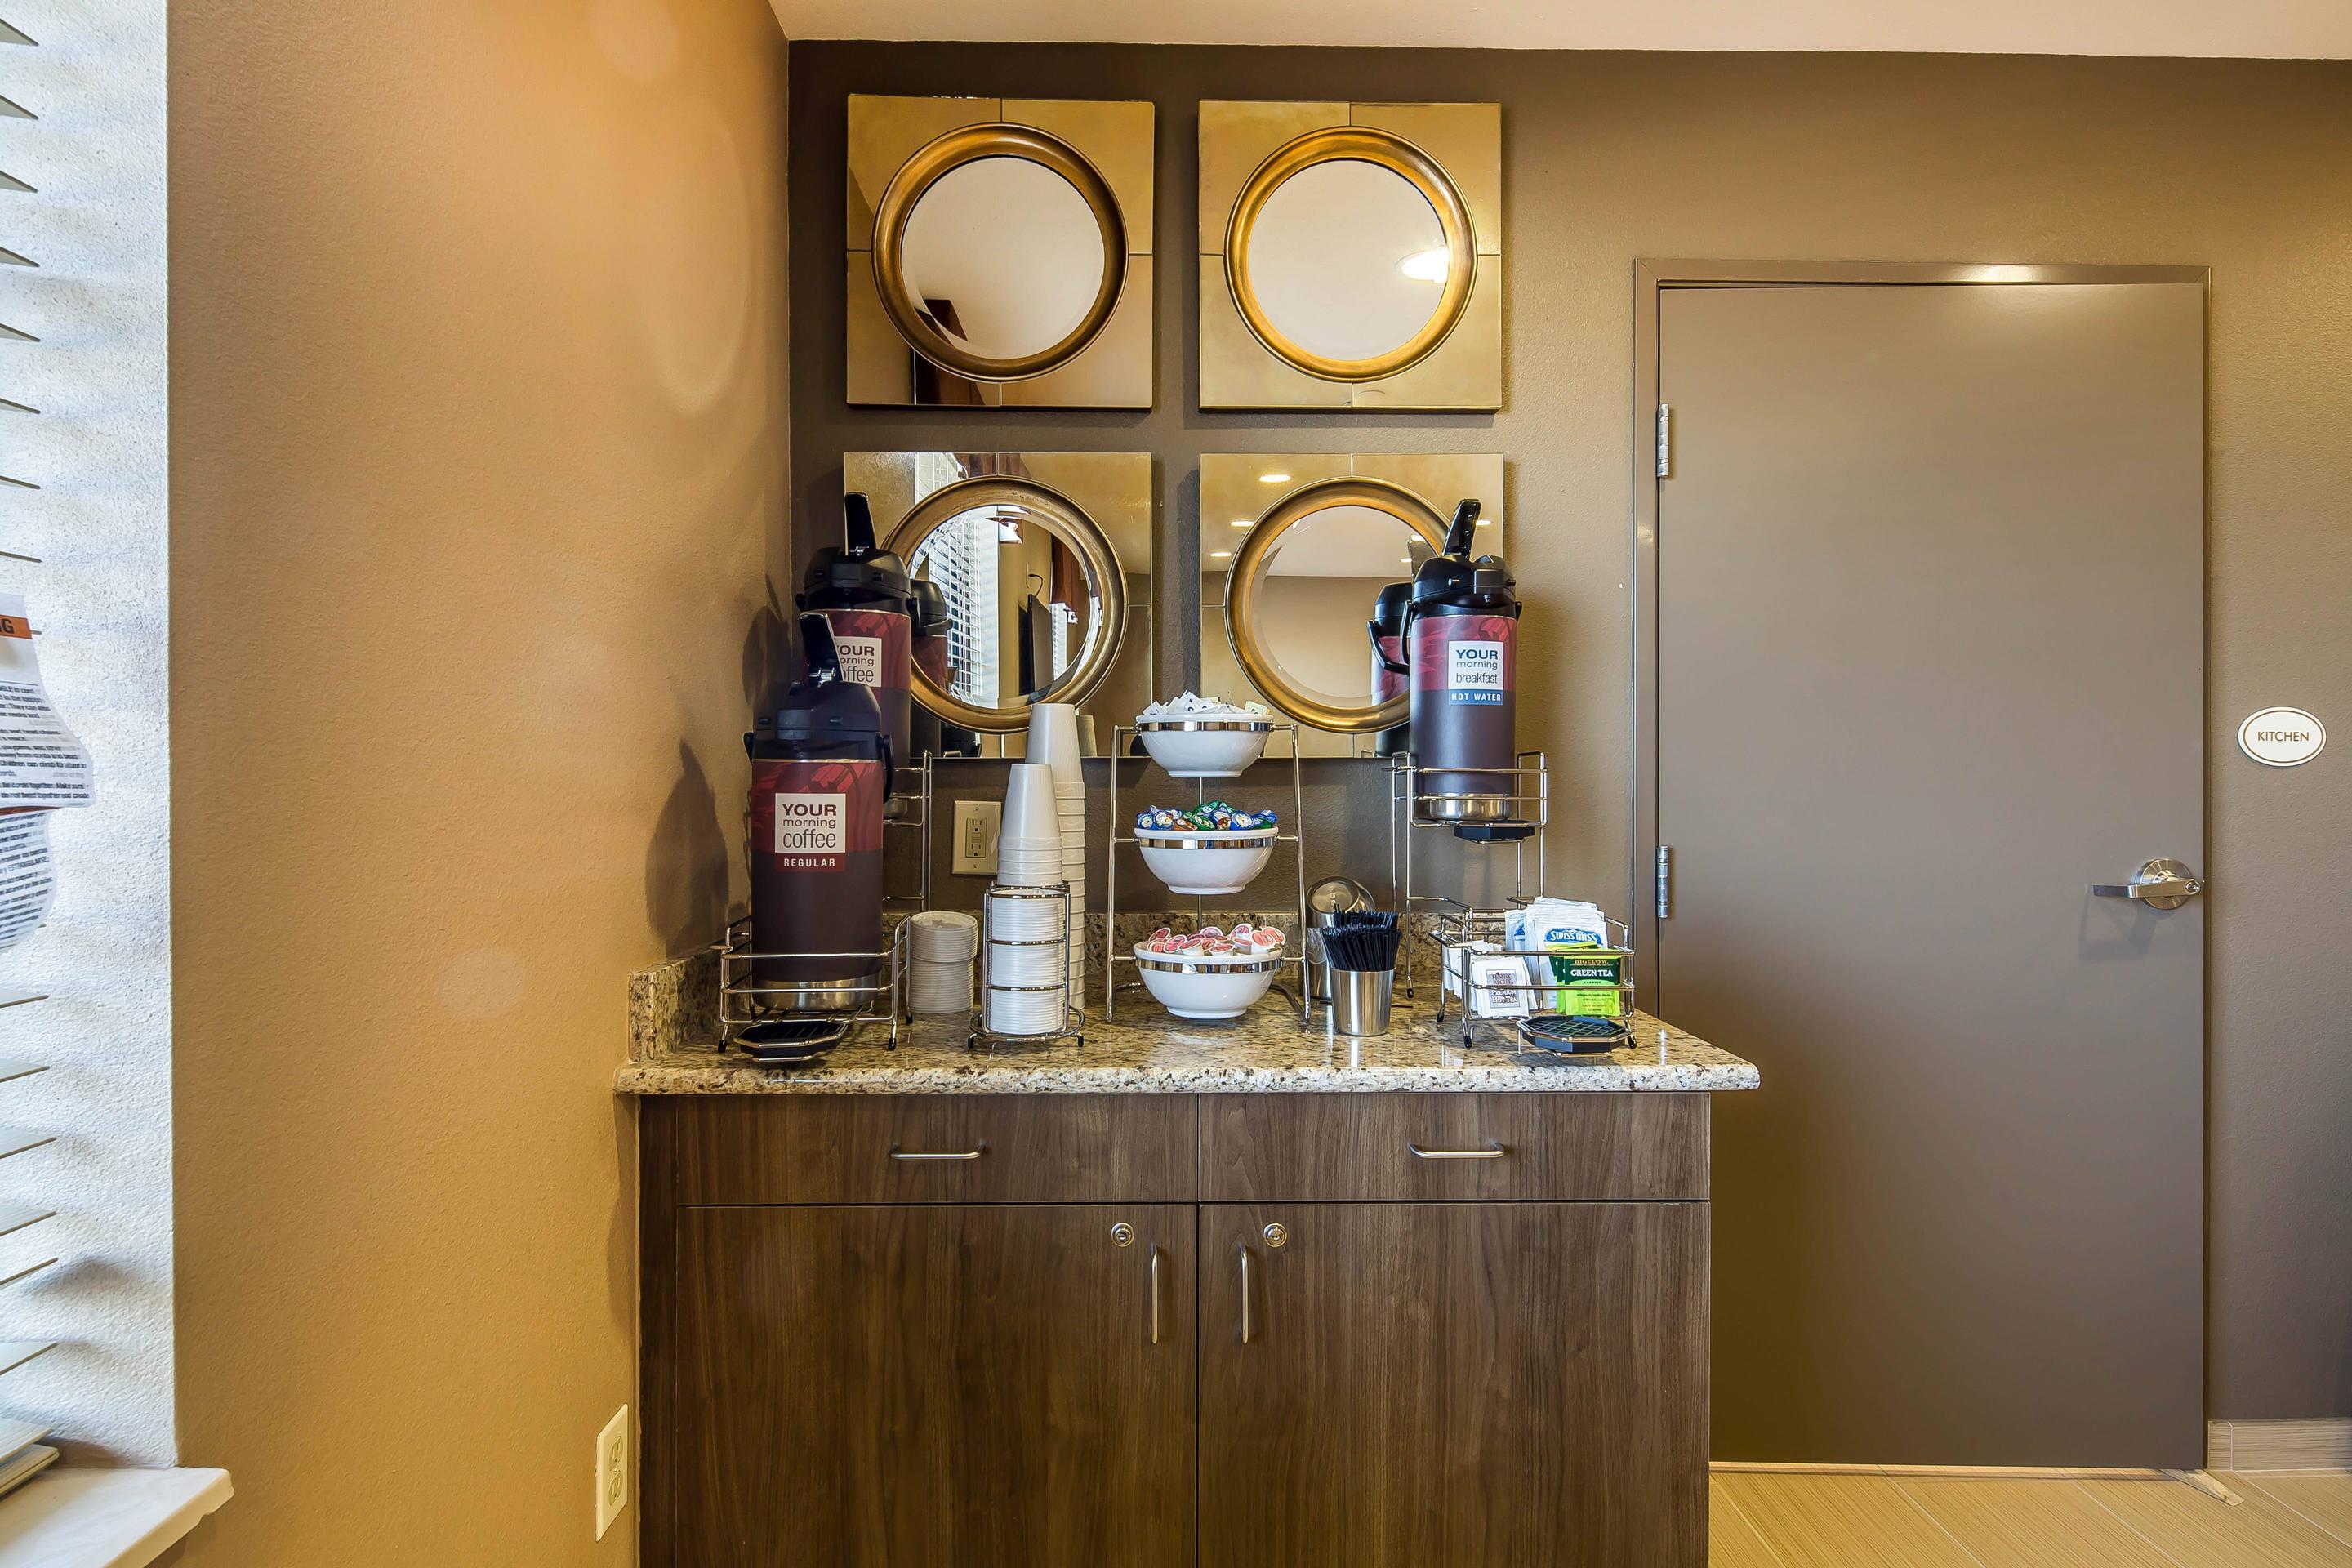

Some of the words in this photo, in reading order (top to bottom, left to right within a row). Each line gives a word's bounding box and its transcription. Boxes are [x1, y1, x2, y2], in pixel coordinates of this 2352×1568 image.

[837, 645, 875, 656] OUR
[1456, 649, 1498, 660] YOUR
[840, 656, 874, 667] orning
[1456, 660, 1498, 670] morning
[842, 666, 874, 683] ffee
[1456, 672, 1498, 684] breakfast
[1451, 693, 1470, 701] HOT
[1473, 693, 1501, 702] WATER
[2257, 731, 2310, 742] KITCHEN
[782, 804, 837, 816] YOUR
[783, 817, 836, 829] morning
[783, 828, 836, 849] coffee
[784, 858, 835, 867] REGULAR
